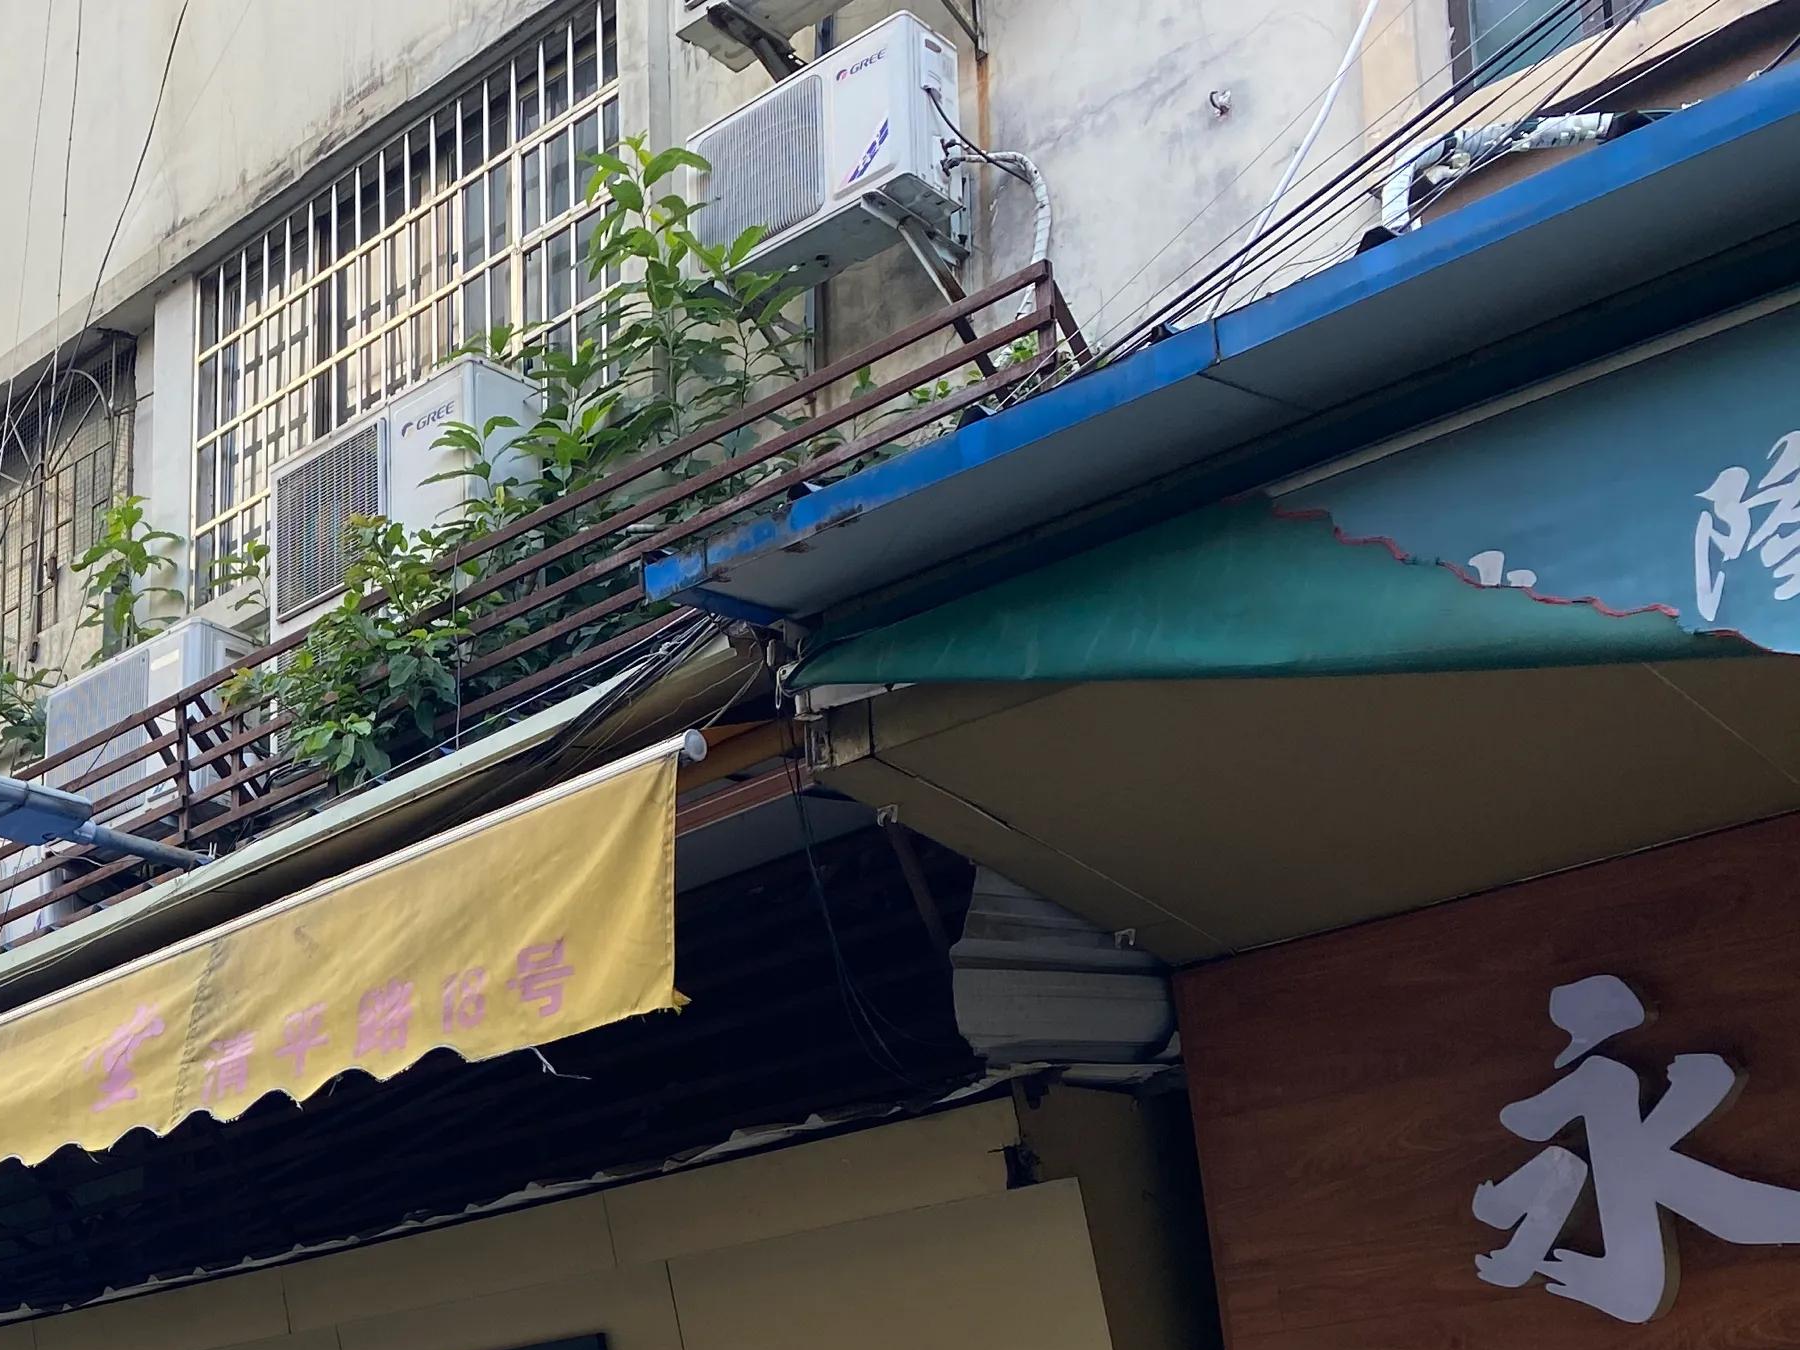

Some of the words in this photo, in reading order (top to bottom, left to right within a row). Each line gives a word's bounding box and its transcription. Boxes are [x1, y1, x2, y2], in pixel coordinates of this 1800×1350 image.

[849, 48, 887, 75] GREE
[416, 400, 455, 431] GREE
[1472, 974, 1800, 1324] 永
